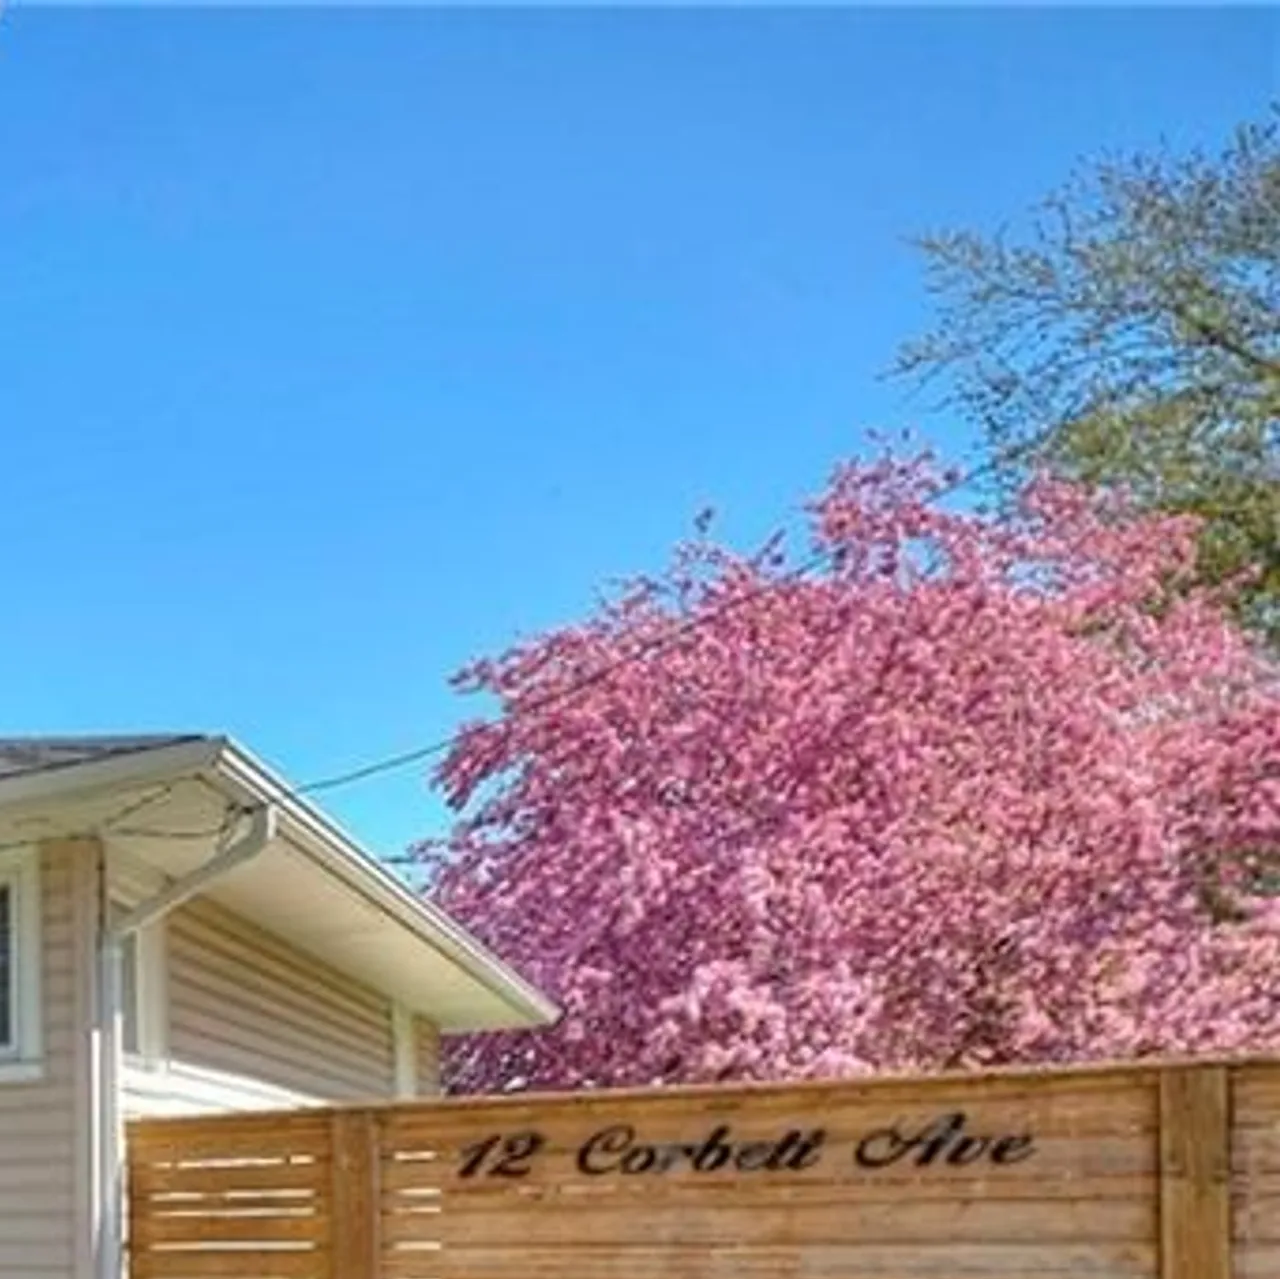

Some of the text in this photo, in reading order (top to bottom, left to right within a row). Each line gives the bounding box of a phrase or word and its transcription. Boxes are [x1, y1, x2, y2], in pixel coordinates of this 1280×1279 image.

[457, 1112, 1034, 1179] 12 Corbett Ave
